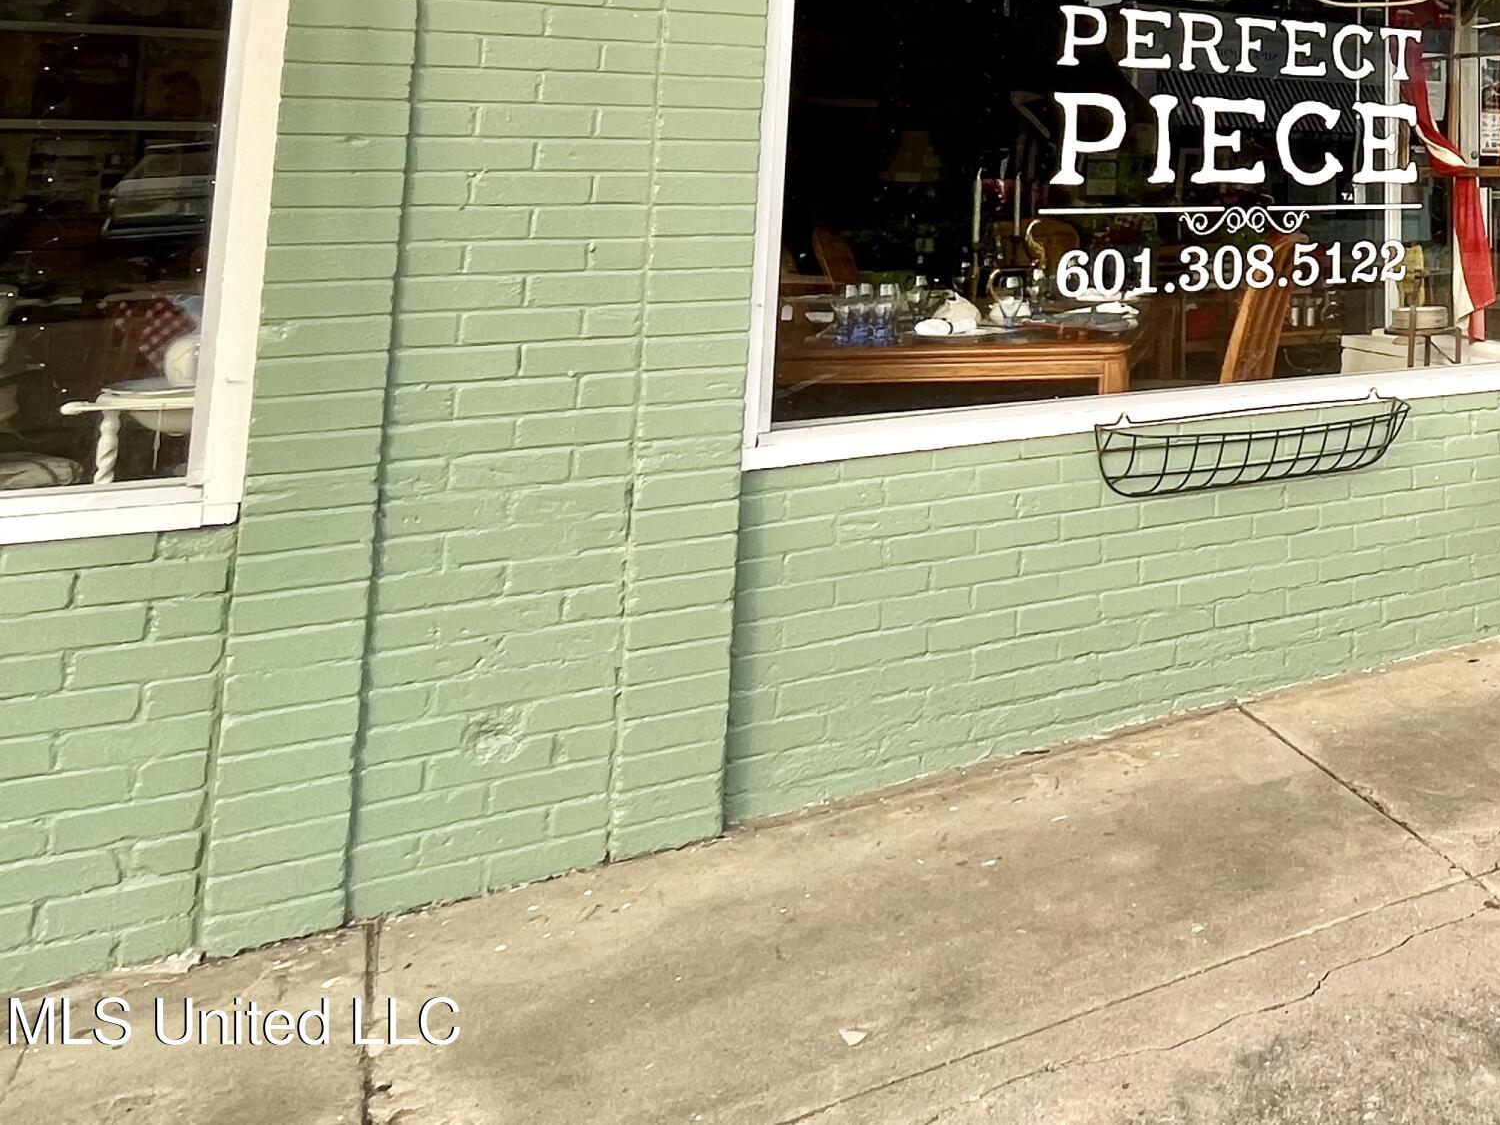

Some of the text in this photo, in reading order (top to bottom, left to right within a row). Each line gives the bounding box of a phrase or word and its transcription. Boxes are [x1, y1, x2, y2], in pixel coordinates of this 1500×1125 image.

[1056, 5, 1422, 81] PERFECT
[1049, 92, 1419, 186] PIECE
[1056, 240, 1407, 299] 601.308.5122
